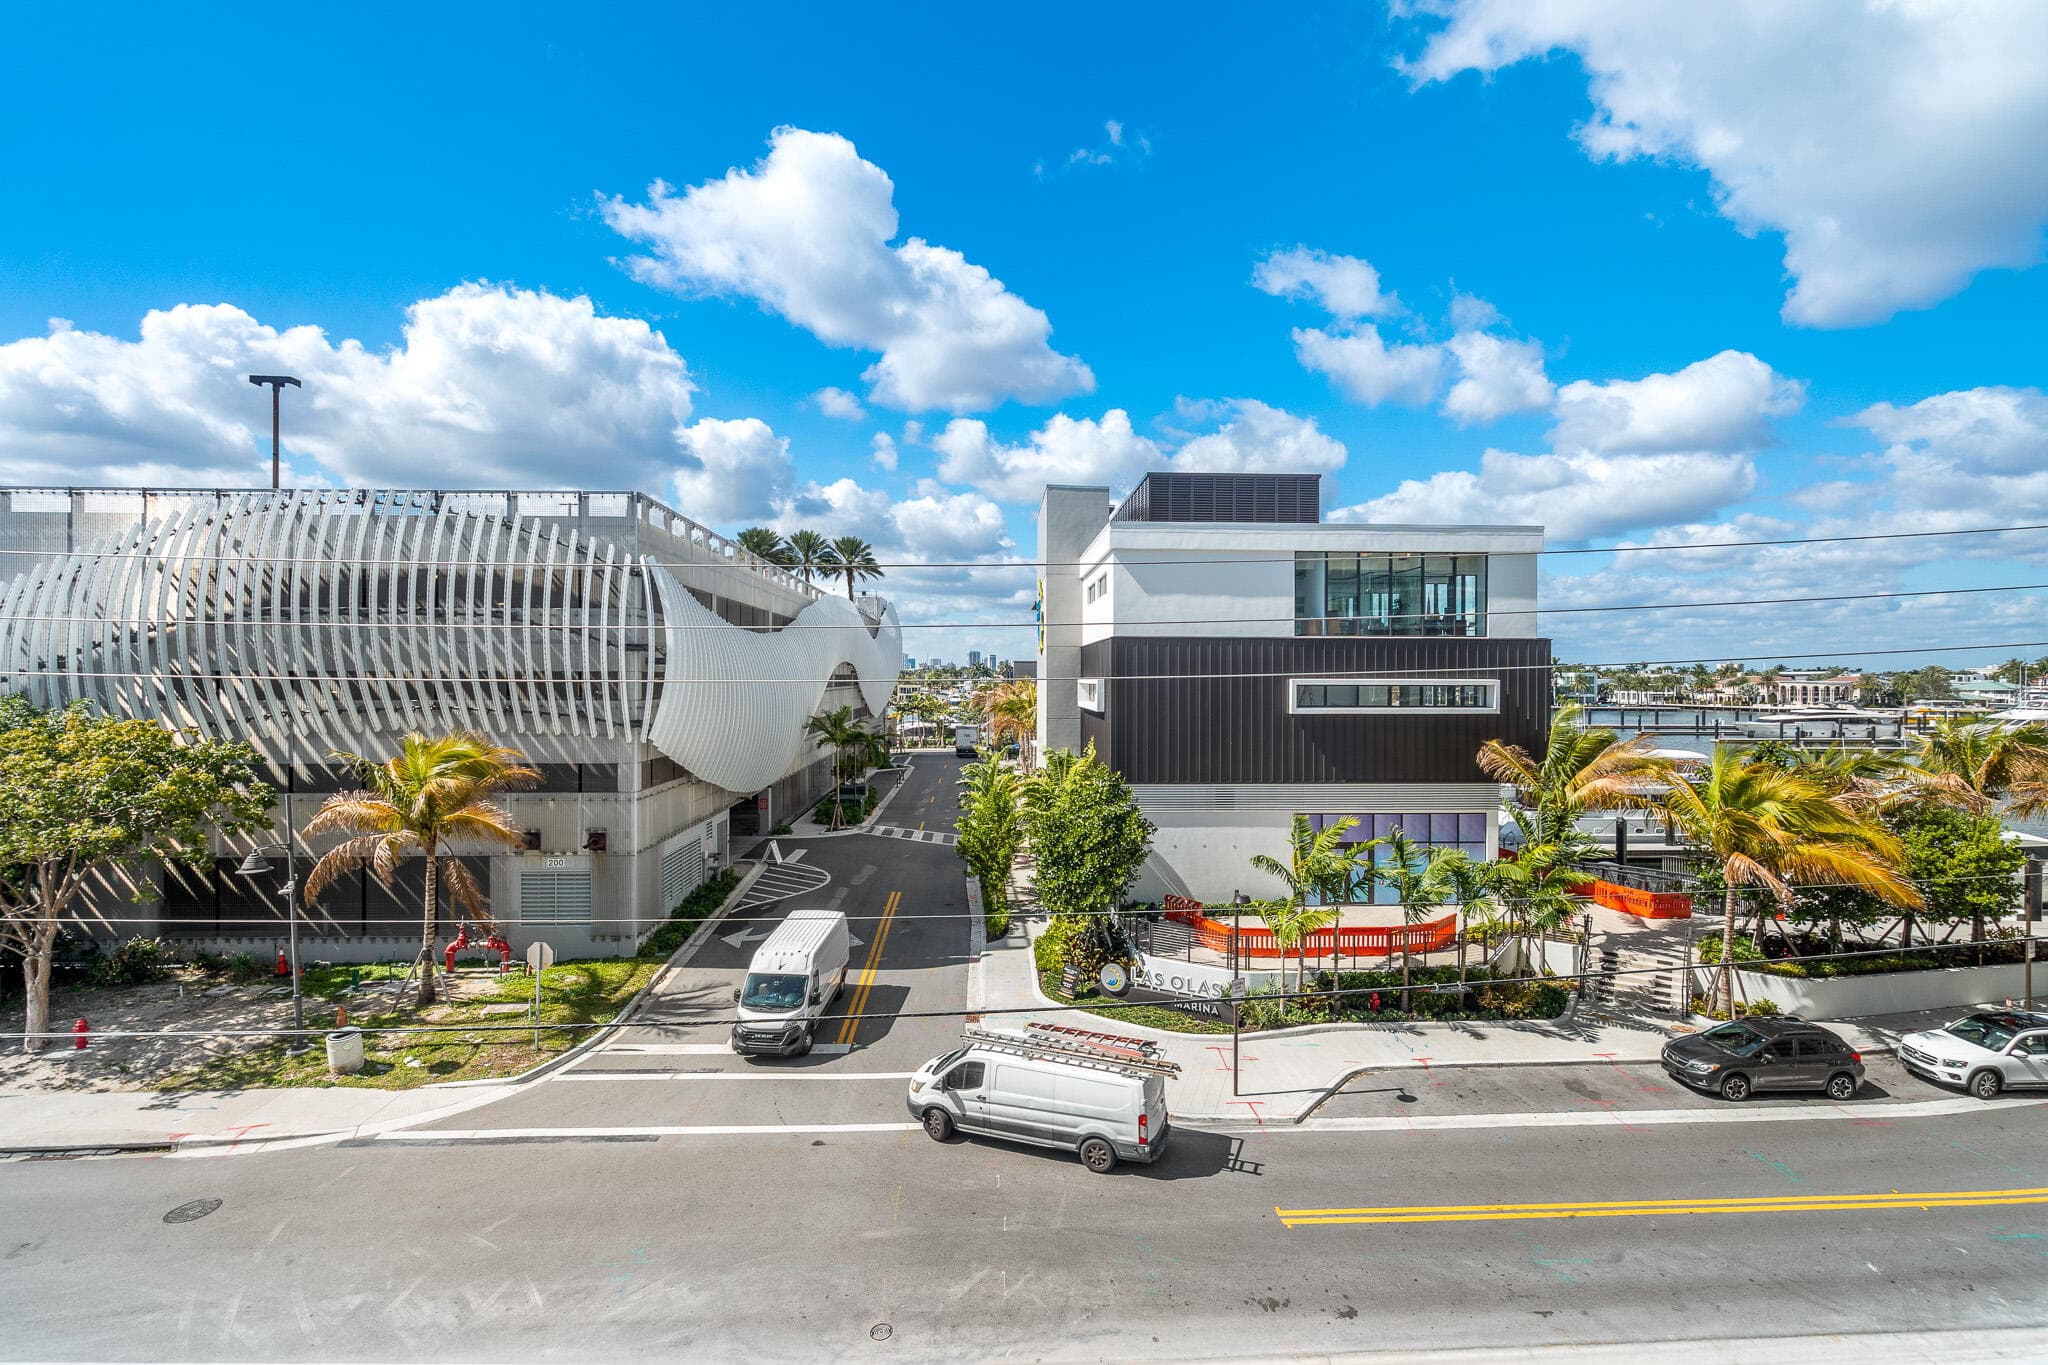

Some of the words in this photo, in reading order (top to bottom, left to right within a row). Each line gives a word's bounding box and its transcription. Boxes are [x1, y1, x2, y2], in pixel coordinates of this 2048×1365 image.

[548, 859, 564, 867] 200
[1130, 966, 1164, 987] LAS
[1170, 975, 1222, 998] OLAS
